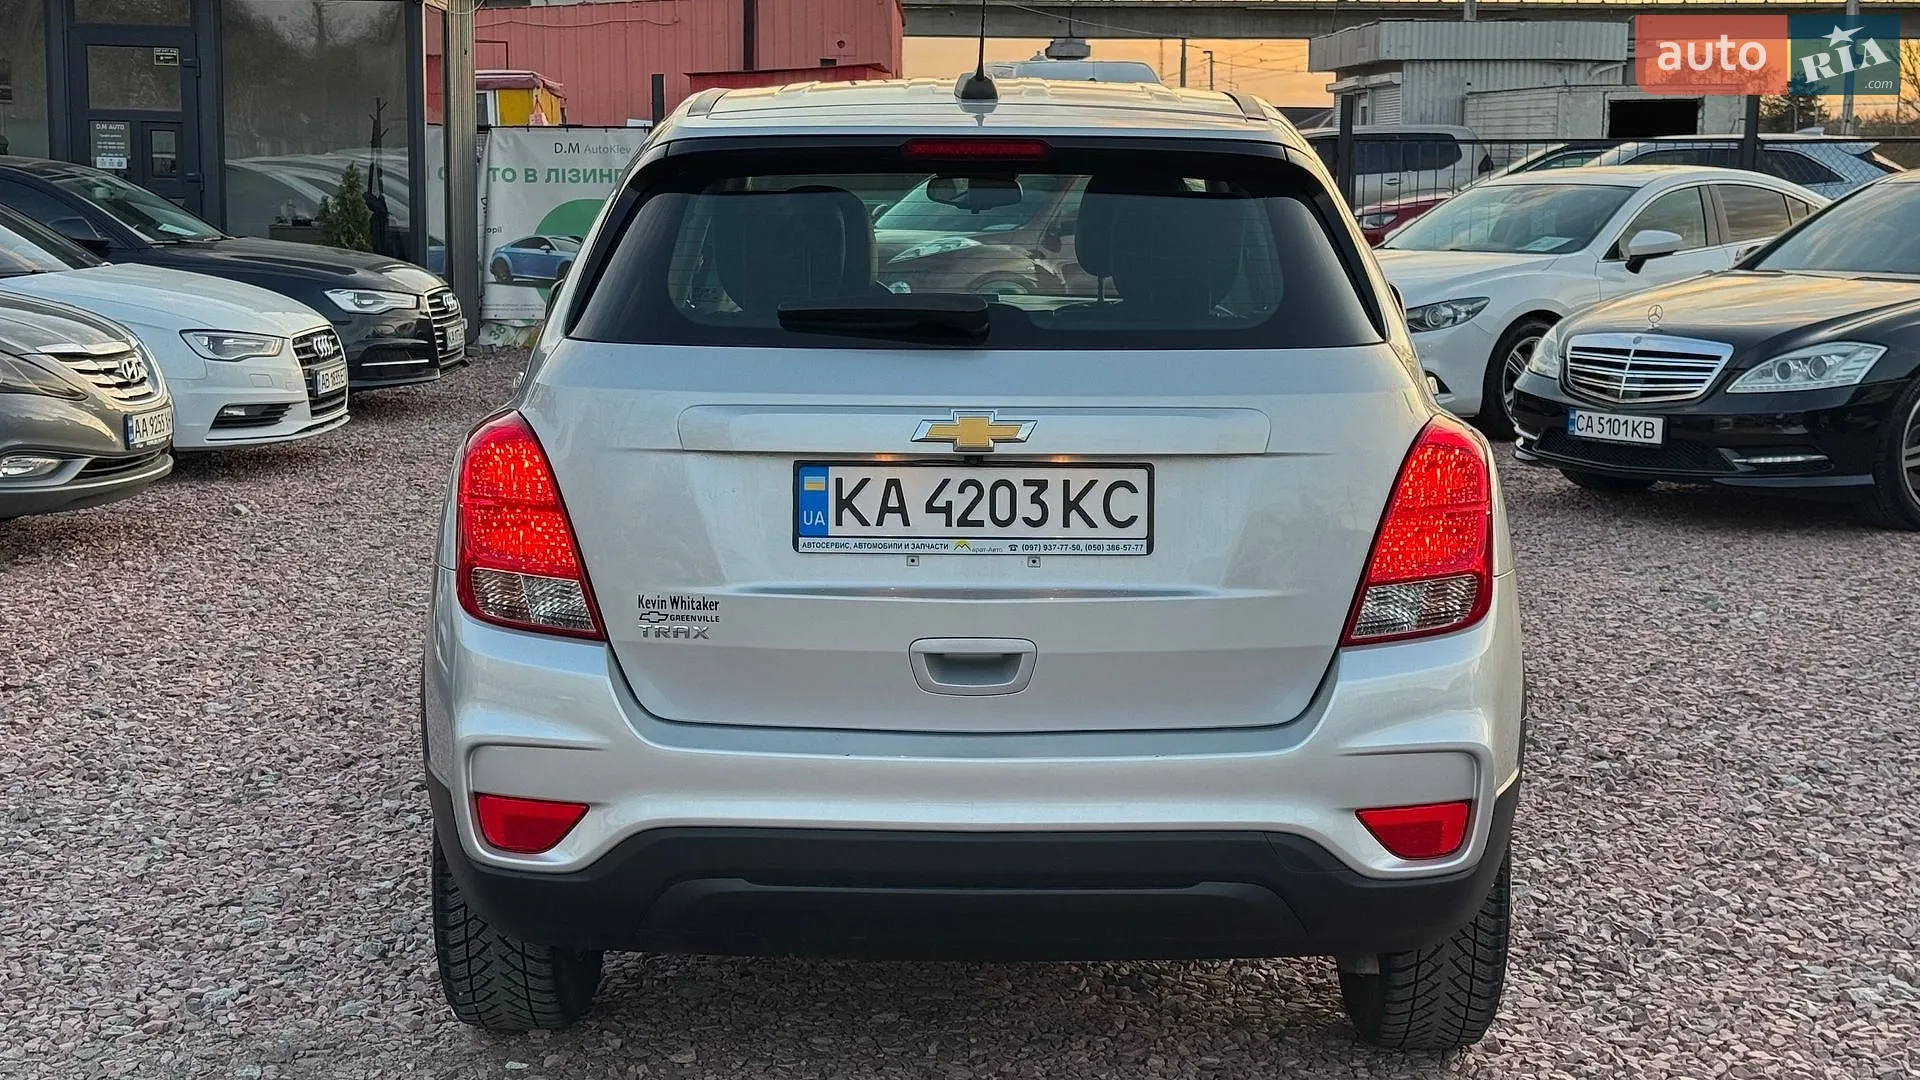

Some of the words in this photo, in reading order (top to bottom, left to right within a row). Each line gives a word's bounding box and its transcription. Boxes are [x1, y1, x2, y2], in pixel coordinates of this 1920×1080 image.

[554, 142, 580, 154] D.M
[524, 167, 538, 183] В
[135, 418, 149, 439] AA
[1576, 414, 1594, 434] CA
[1597, 416, 1629, 438] 5101
[1631, 420, 1655, 439] KB
[835, 477, 911, 527] KA
[925, 478, 1049, 528] 4203
[1062, 479, 1139, 529] KC
[803, 511, 826, 526] UA
[802, 541, 851, 550] АВТОСЕРВИС,
[854, 542, 903, 550] АВТОМОБИЛИ
[1021, 543, 1041, 552] (097)
[1043, 543, 1082, 552] 937-77-50,
[1085, 543, 1104, 552] (050)
[1106, 543, 1144, 552] 386-57-77
[638, 594, 667, 610] Kevin
[669, 595, 720, 611] Whitaker
[669, 614, 720, 622] GREENVILLE
[638, 624, 710, 640] TRAX
